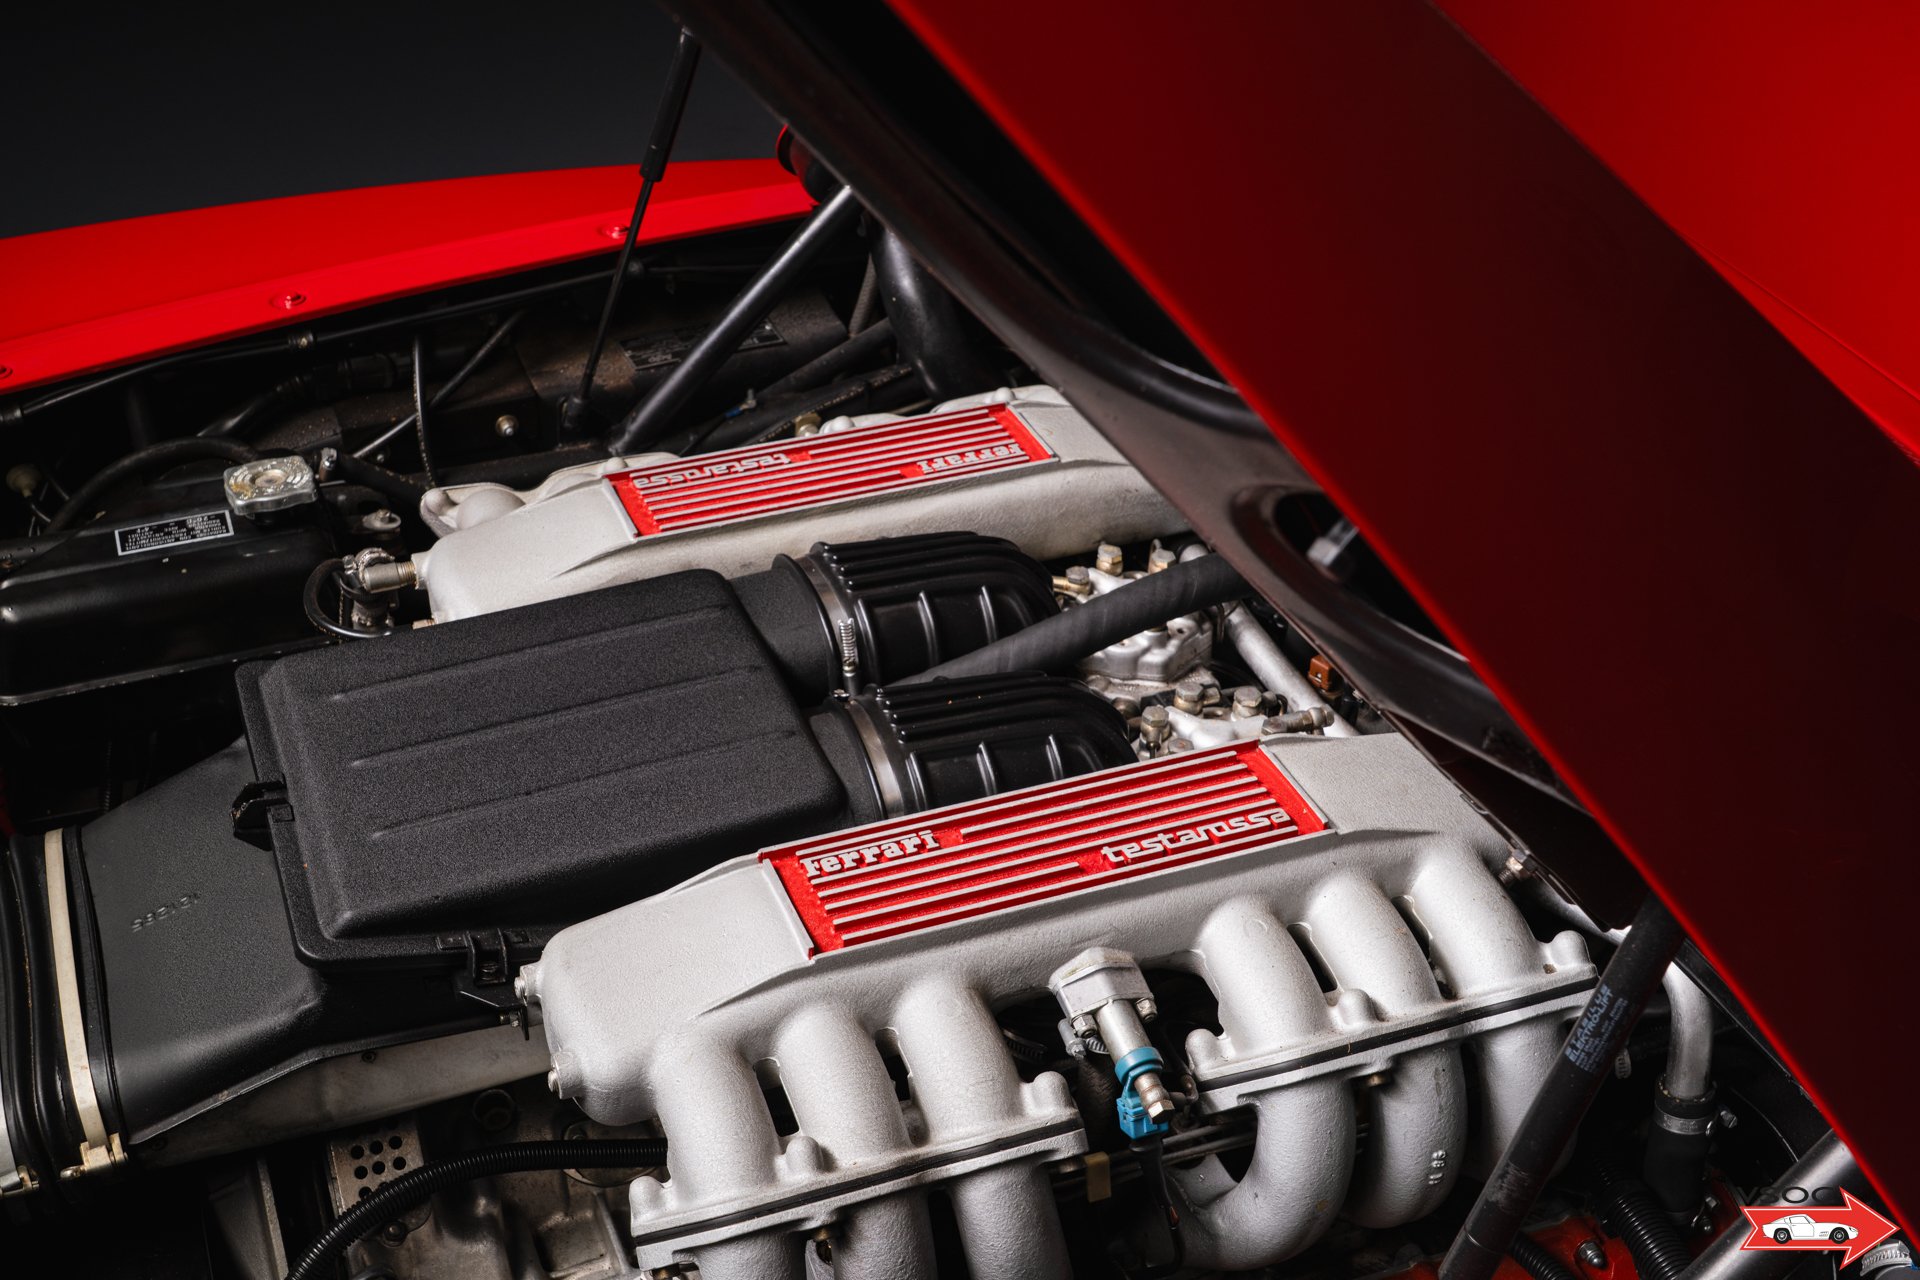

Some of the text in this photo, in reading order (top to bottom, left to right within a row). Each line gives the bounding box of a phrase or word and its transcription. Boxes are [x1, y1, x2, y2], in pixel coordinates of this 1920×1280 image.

[630, 453, 790, 489] testarossa
[917, 444, 1023, 475] Ferrari
[799, 829, 936, 877] Ferrari
[1101, 807, 1291, 863] testarossa
[1565, 984, 1608, 1055] STABILUS
[1568, 989, 1613, 1061] ELEKTRO-LIFT
